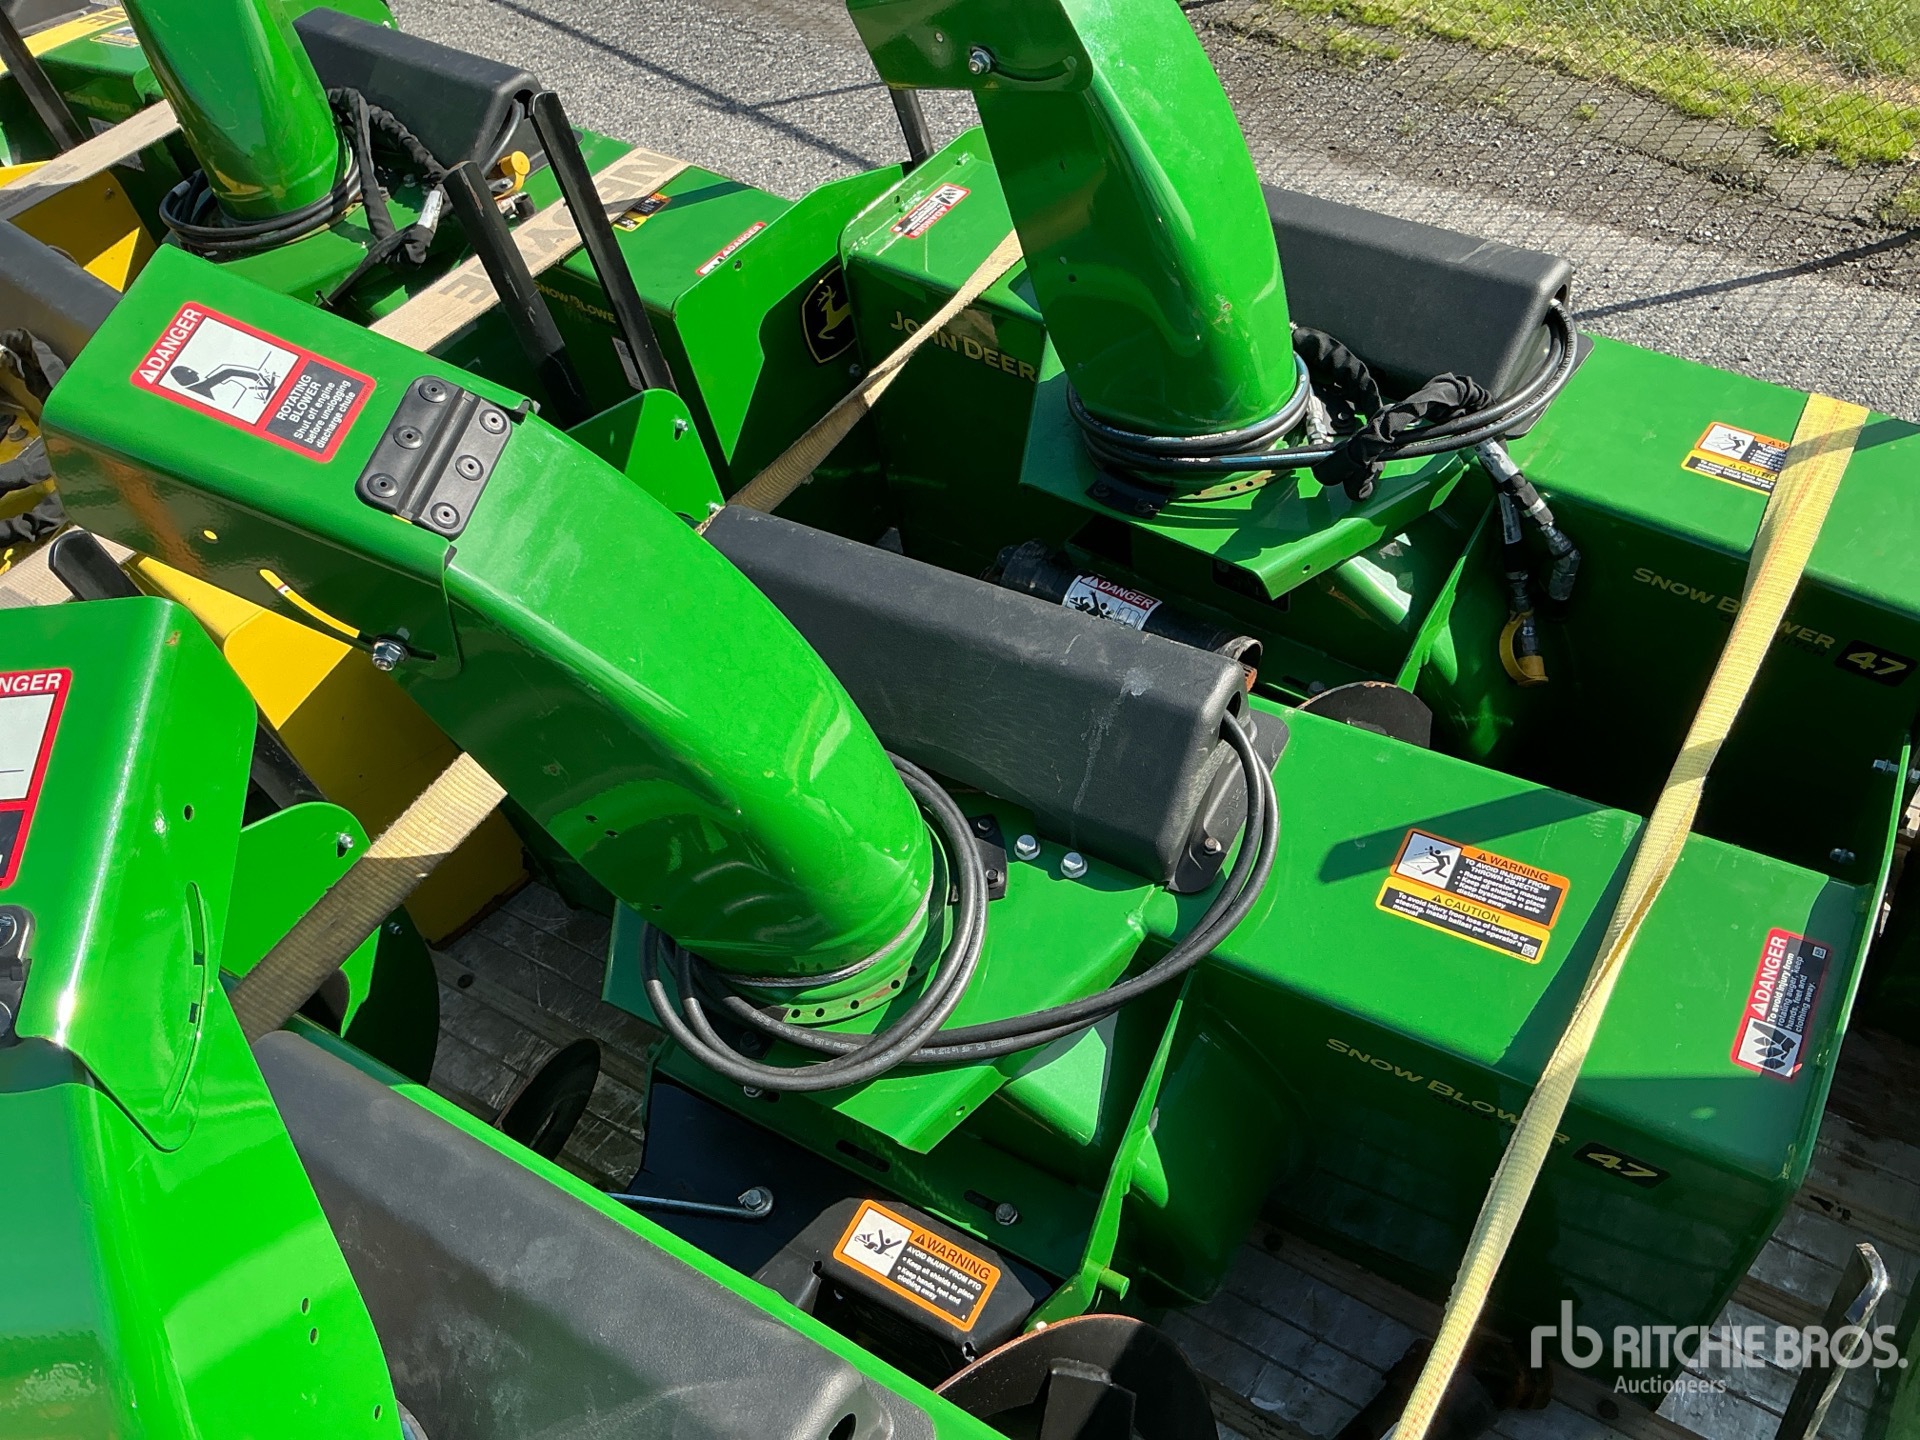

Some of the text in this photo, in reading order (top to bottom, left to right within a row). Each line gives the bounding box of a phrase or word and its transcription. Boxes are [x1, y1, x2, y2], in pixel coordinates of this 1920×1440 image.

[569, 295, 617, 324] BLOWE
[146, 308, 202, 371] DANGER
[962, 336, 1036, 383] DEER
[275, 374, 312, 421] ROTATING
[288, 381, 322, 423] BLOWER
[293, 382, 336, 440] Shut off engine
[304, 380, 352, 444] before unclogging
[316, 392, 356, 449] discharge chute
[1738, 467, 1777, 481] CAUTIO
[1099, 580, 1155, 609] DANGER
[1632, 567, 1836, 649] SNOW BWER
[0, 672, 63, 693] NGER
[1846, 651, 1908, 676] 47
[1461, 876, 1480, 887] Keep
[1490, 885, 1517, 900] shields
[1463, 870, 1547, 903] Read operator's manual
[1465, 858, 1551, 891] TO AVOID INJURY FROM
[1471, 866, 1539, 894] THROWN OBJECTS
[1490, 855, 1550, 882] WARNING
[1398, 891, 1407, 900] To
[1407, 896, 1428, 906] avoid
[1427, 902, 1448, 915] injury
[1448, 909, 1466, 920] from
[1444, 898, 1501, 924] CAUTION
[1459, 882, 1478, 893] Keep
[1478, 888, 1517, 906] bystanders
[1754, 936, 1788, 1005] DANGER
[1766, 952, 1795, 1023] To avoid injury from
[1777, 956, 1804, 1027] rotating auger, keep
[1785, 974, 1808, 1030] hands, feet and
[1795, 981, 1816, 1032] clothing away.
[1326, 1038, 1571, 1145] SNOW BLOWR
[1586, 1152, 1659, 1178] 47
[906, 1246, 982, 1291] AVOID INJURY FROM PTO
[906, 1258, 922, 1271] Keep
[929, 1271, 951, 1287] shields
[957, 1287, 975, 1300] place
[926, 1237, 992, 1281] WARNING
[897, 1274, 937, 1301] clothing away
[901, 1267, 917, 1280] Keep
[948, 1294, 962, 1305] and
